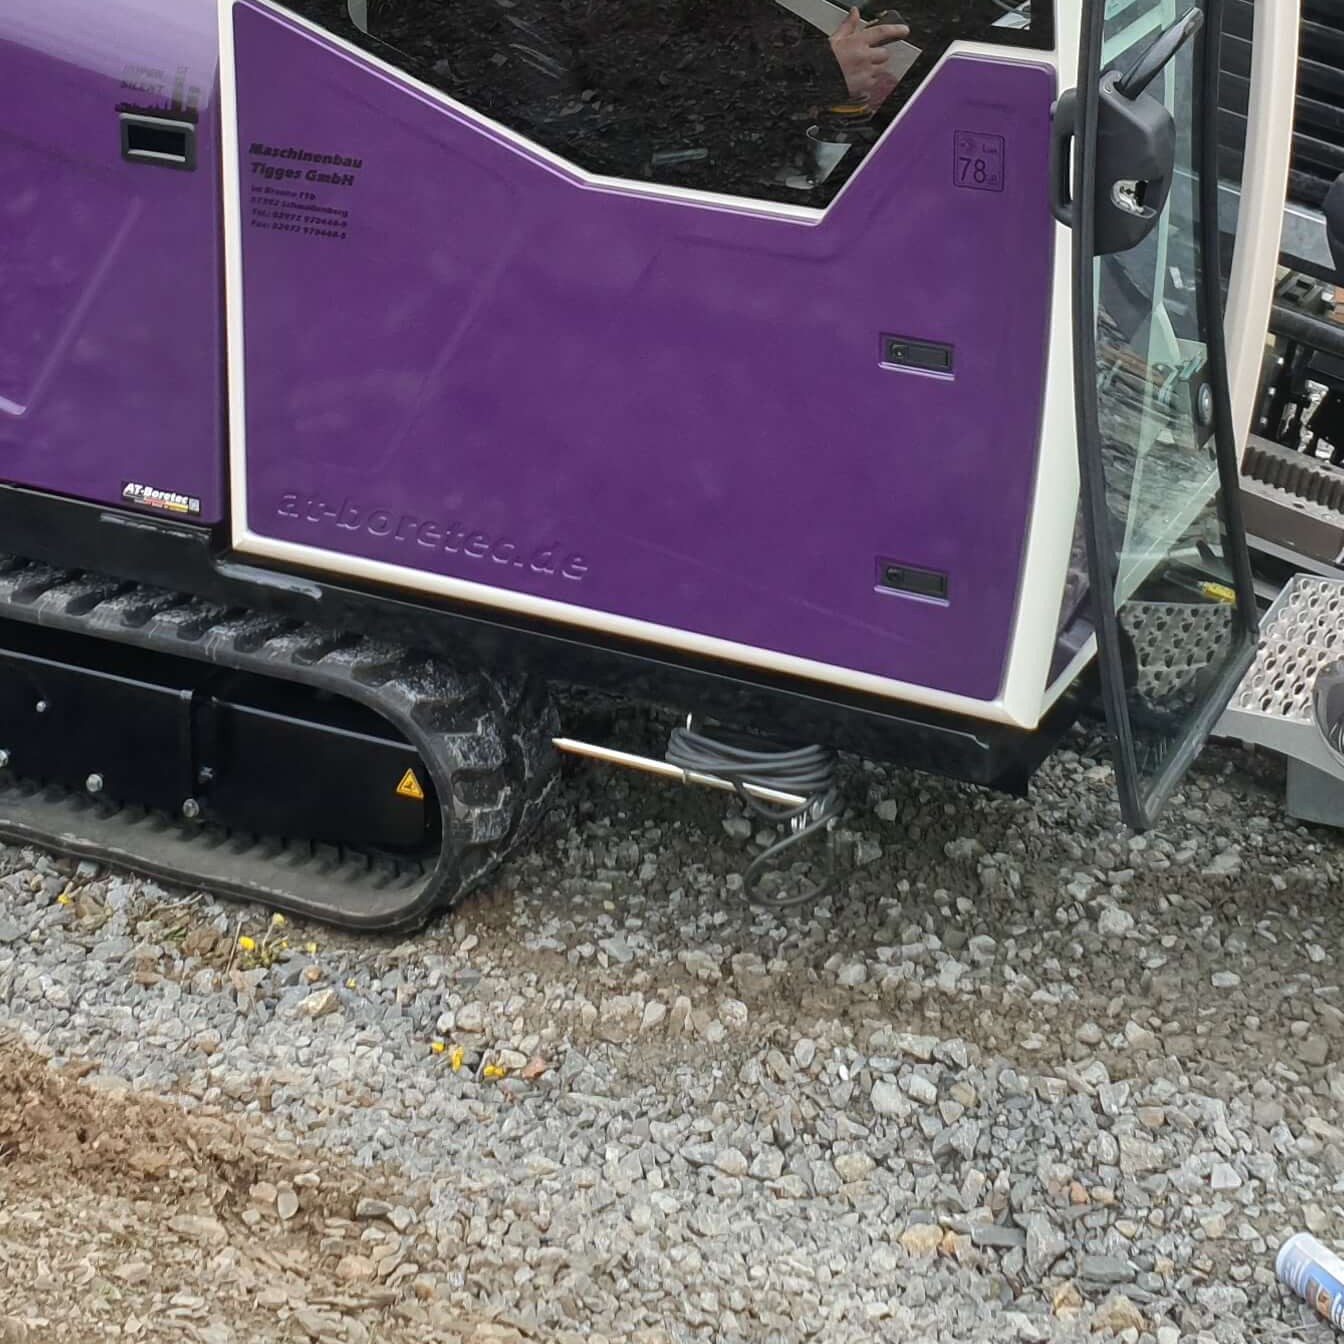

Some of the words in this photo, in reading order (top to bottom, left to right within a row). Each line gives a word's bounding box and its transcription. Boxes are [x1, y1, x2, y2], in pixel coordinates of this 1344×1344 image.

[248, 143, 362, 169] Maschinenbau
[250, 161, 303, 180] Tigges
[304, 169, 355, 186] GmbH
[959, 157, 986, 184] 78
